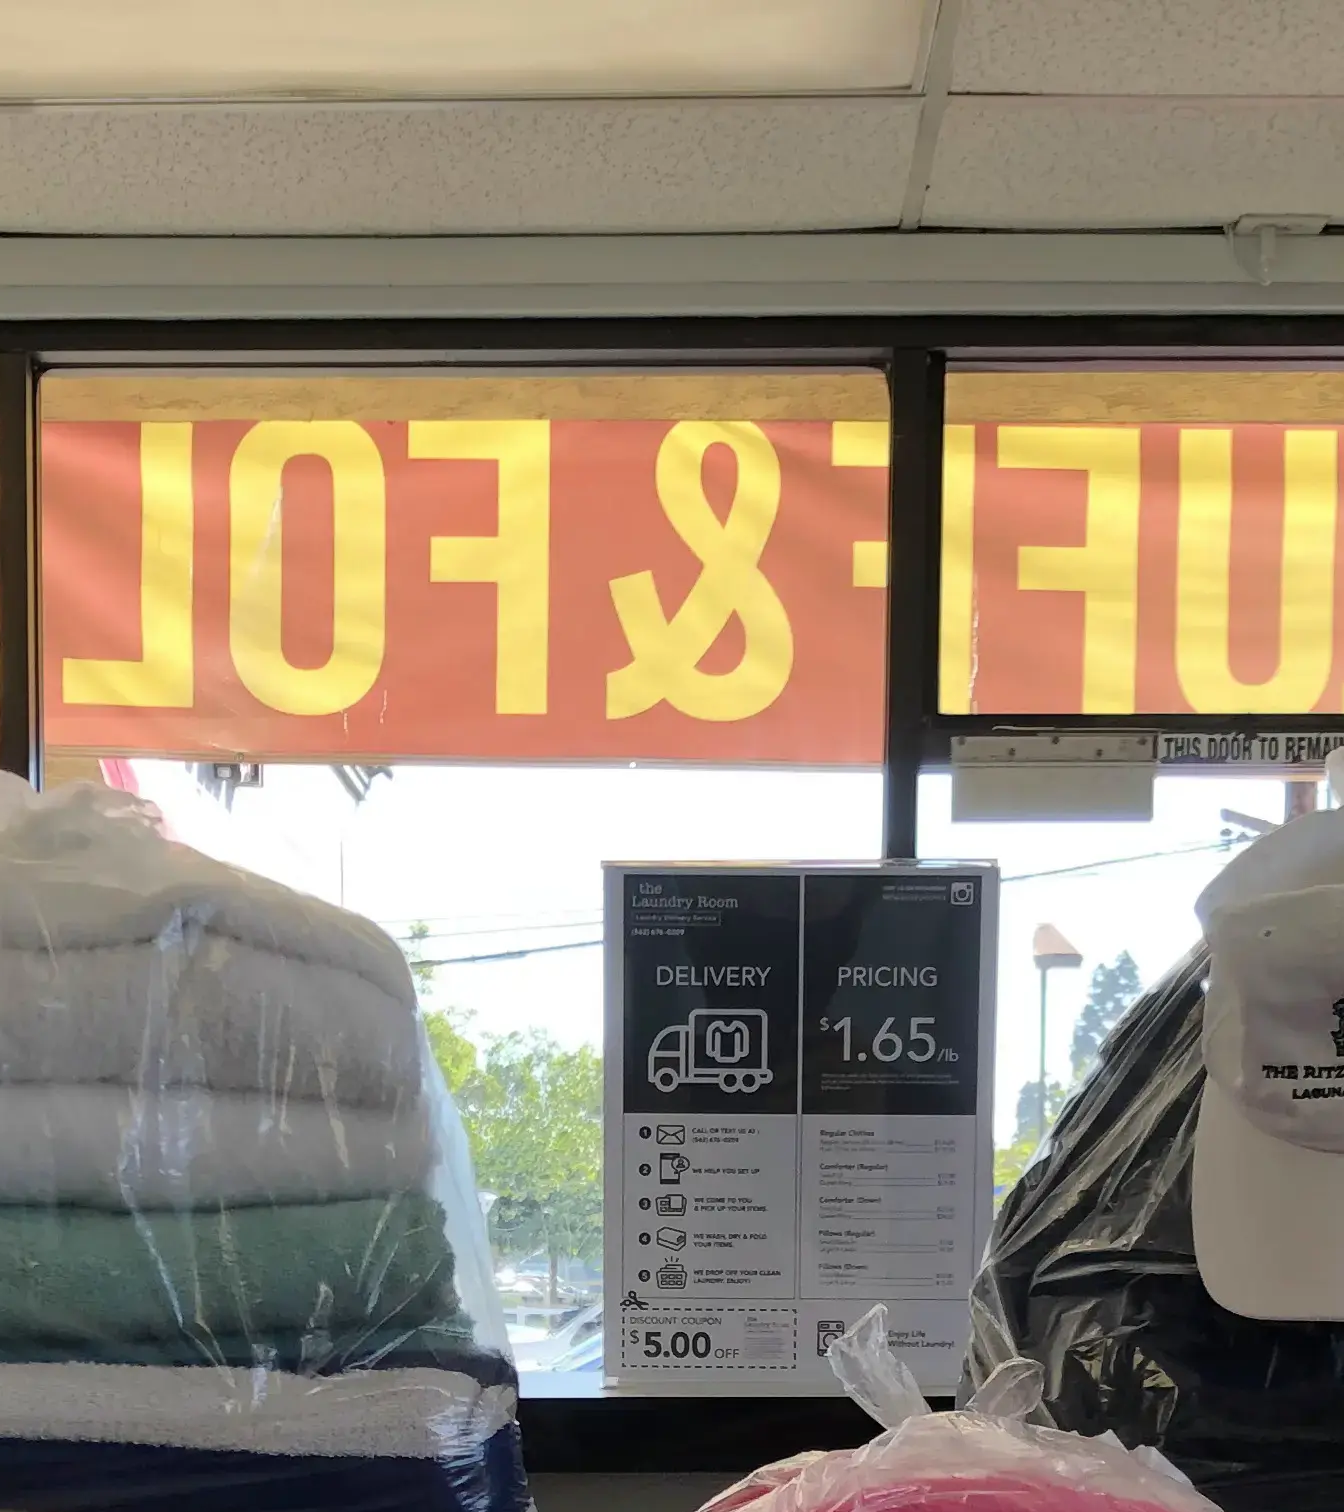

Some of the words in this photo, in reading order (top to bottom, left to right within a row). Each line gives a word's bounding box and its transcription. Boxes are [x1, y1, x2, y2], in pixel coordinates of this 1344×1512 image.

[1164, 736, 1202, 760] THIS
[1207, 736, 1253, 760] DOOR
[1259, 736, 1279, 760] TO
[639, 882, 663, 895] the
[631, 895, 694, 910] Laundry
[697, 895, 739, 909] Room
[656, 966, 772, 987] DELIVERY
[838, 966, 939, 987] PRICING
[1262, 1064, 1300, 1080] THE
[629, 1316, 678, 1325] DISCOUNT
[680, 1317, 722, 1326] COUPON
[714, 1348, 740, 1359] OFF
